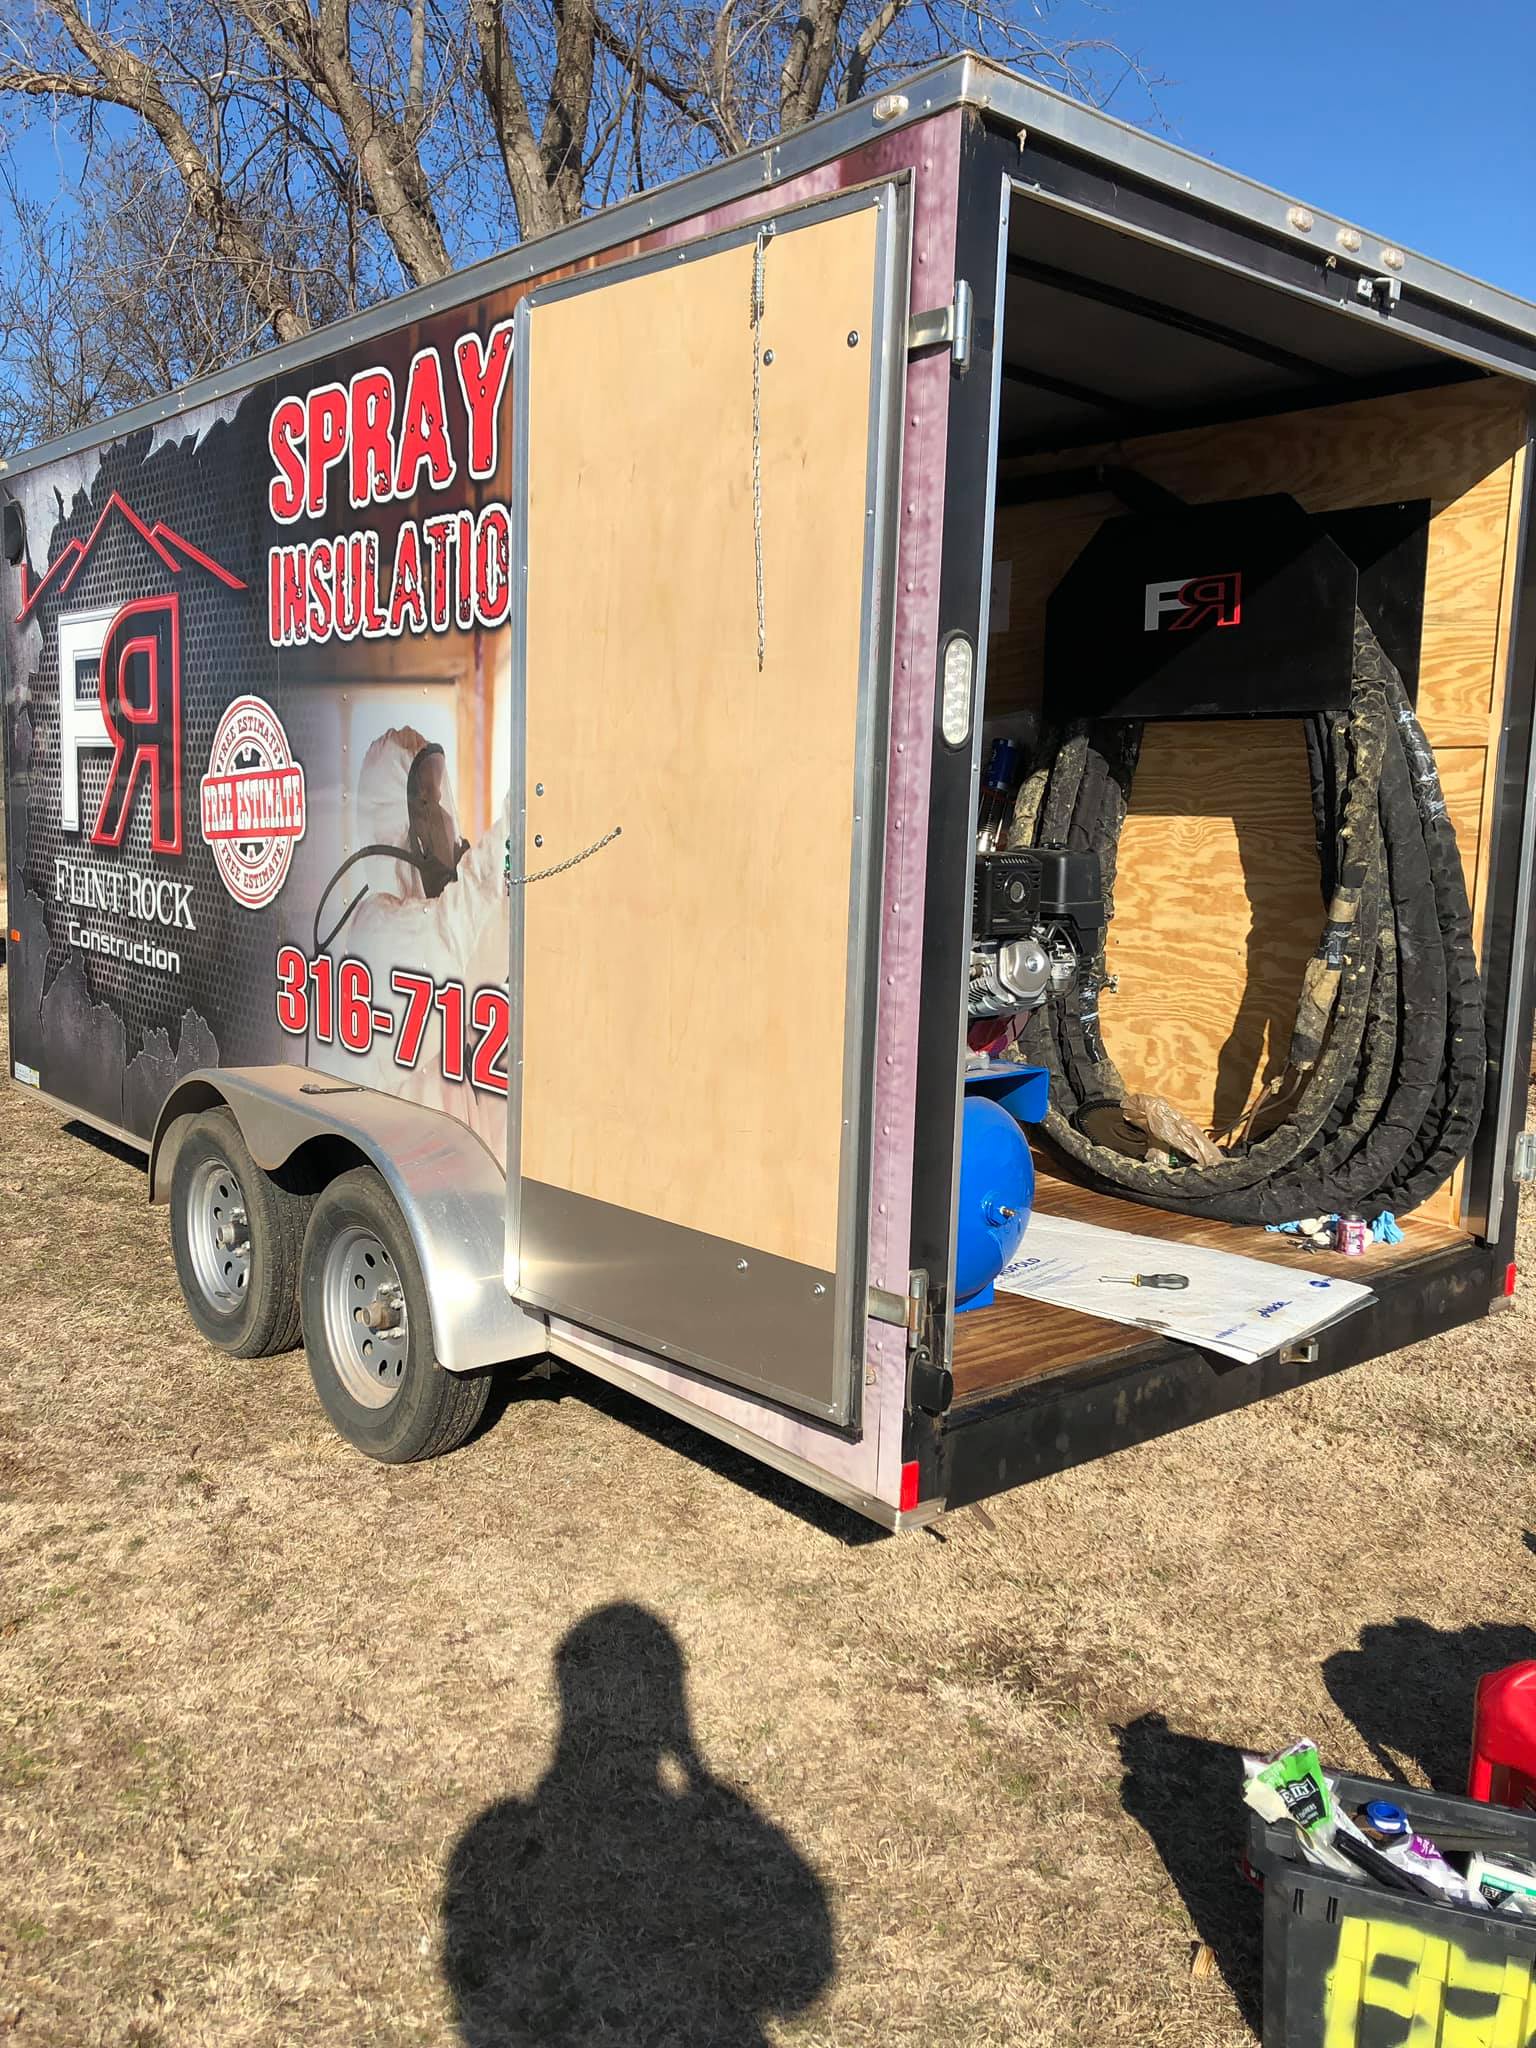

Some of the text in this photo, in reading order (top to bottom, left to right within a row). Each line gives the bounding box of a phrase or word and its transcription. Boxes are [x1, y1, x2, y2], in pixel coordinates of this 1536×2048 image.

[269, 318, 514, 524] SPRAY
[268, 502, 512, 648] INSULATIO
[218, 715, 282, 766] FREE ESTIMATE
[203, 774, 302, 833] FREE ESTIMATE
[54, 858, 197, 931] FLINT ROCK
[221, 842, 284, 889] FREE ESTIMATE
[69, 920, 181, 974] Construction
[276, 945, 508, 1096] 316-712
